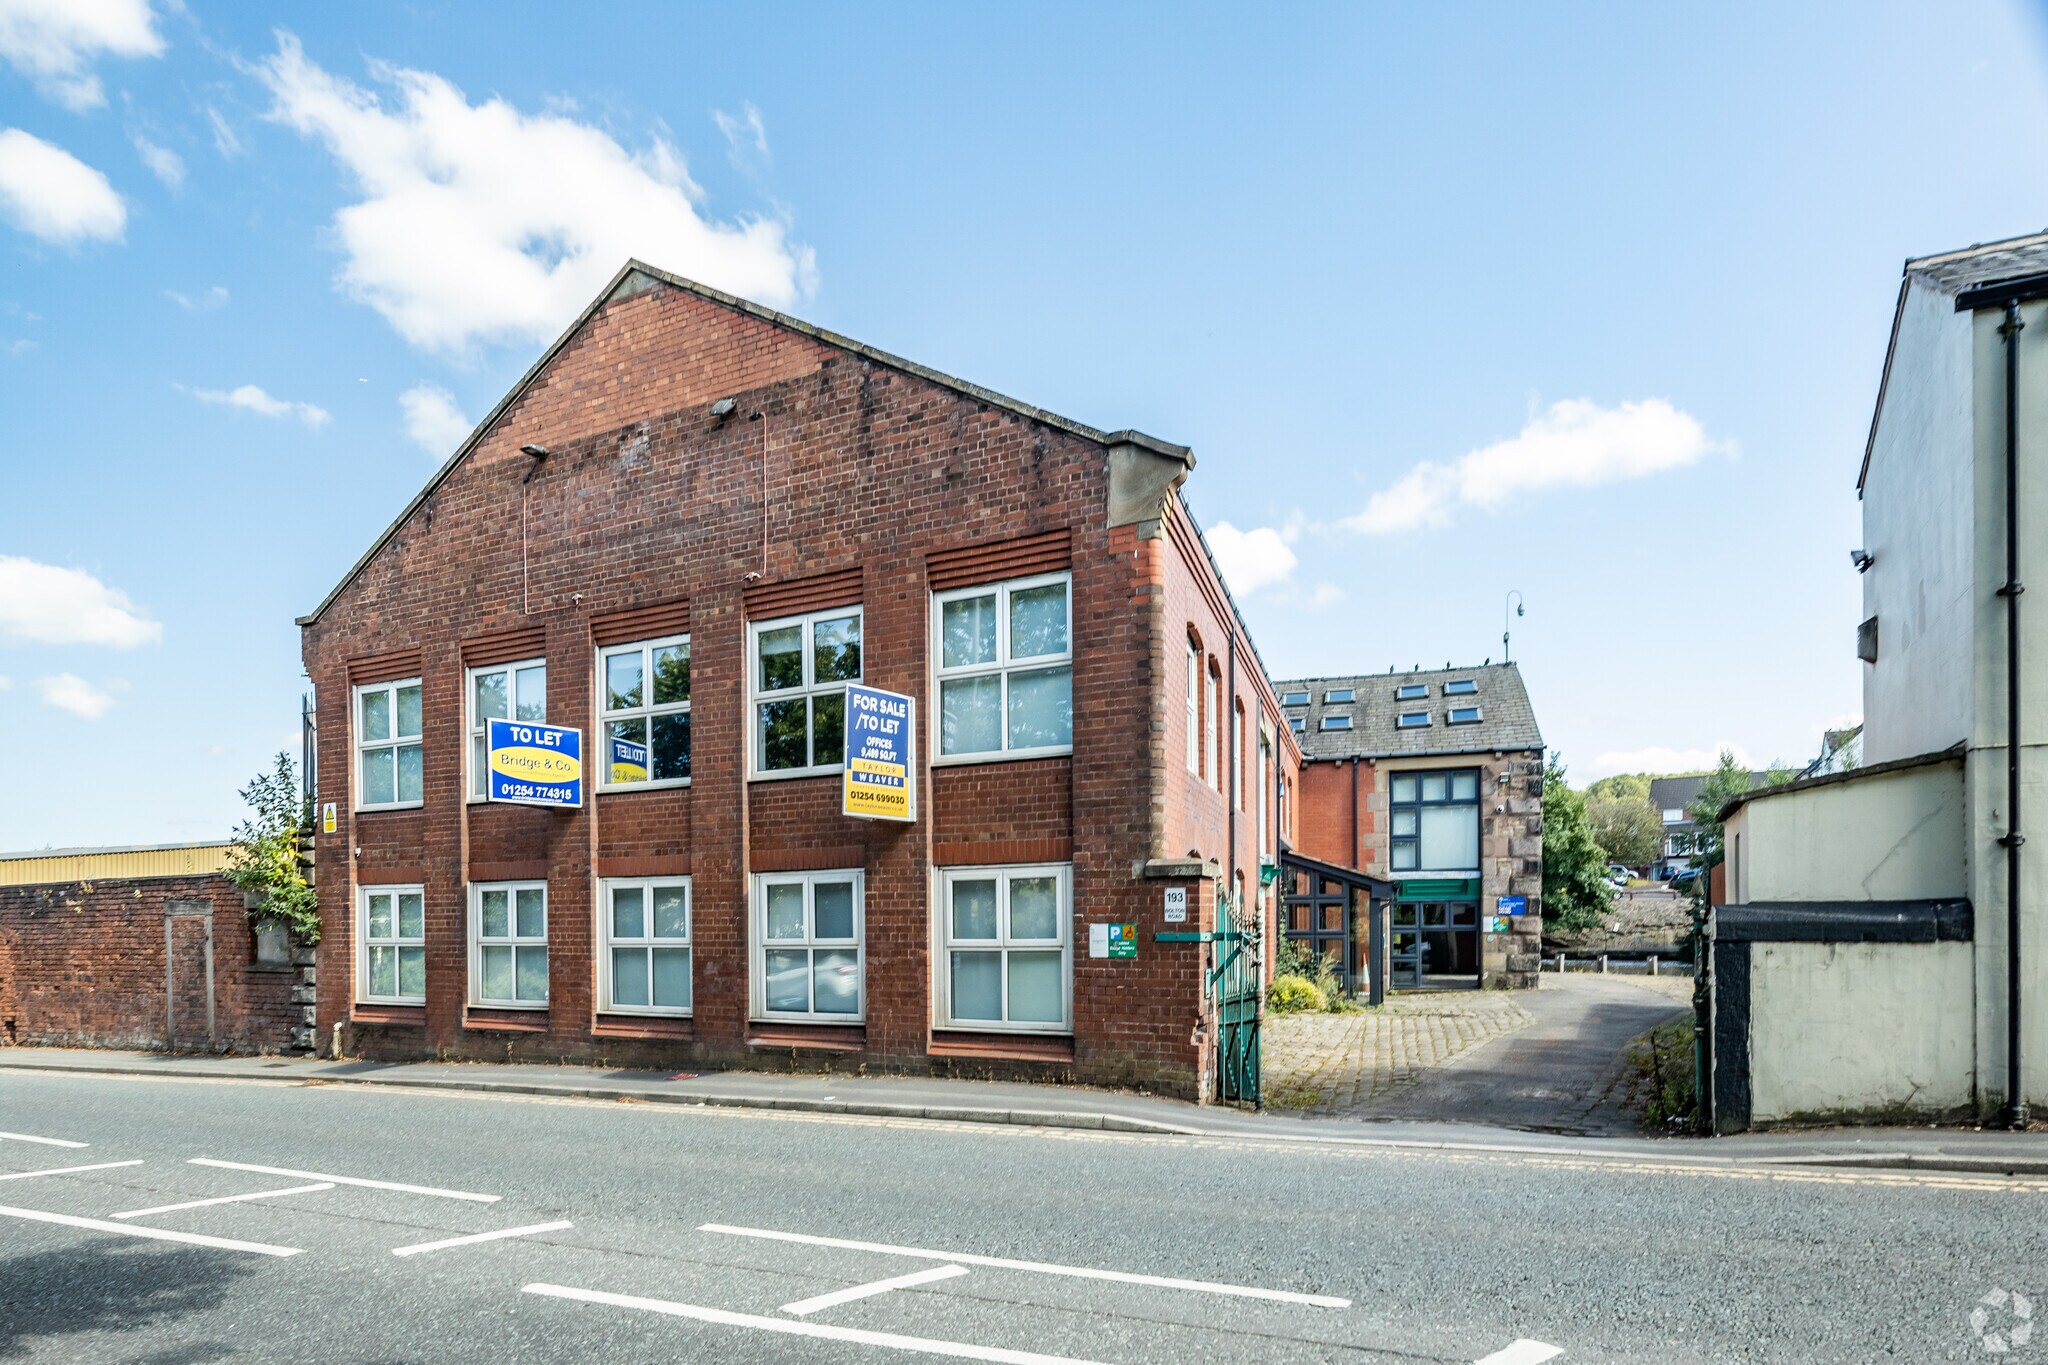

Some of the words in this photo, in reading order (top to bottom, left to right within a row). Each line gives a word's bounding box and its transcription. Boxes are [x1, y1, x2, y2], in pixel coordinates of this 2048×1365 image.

[853, 693, 878, 712] FOR
[880, 699, 906, 718] SALE
[855, 712, 879, 731] /TO
[880, 717, 900, 735] LET
[510, 726, 532, 743] TO
[535, 729, 563, 747] LET
[866, 736, 892, 749] OFFICES
[501, 754, 541, 770] Bridge
[544, 758, 552, 770] &
[556, 760, 574, 773] Co.
[863, 762, 897, 774] TAYLOR
[859, 772, 899, 786] WEAVER
[501, 783, 534, 797] 01254
[535, 786, 572, 800] 774315
[850, 790, 875, 801] 01254
[875, 793, 905, 805] 699030
[1167, 892, 1183, 902] 193
[1110, 926, 1121, 940] P
